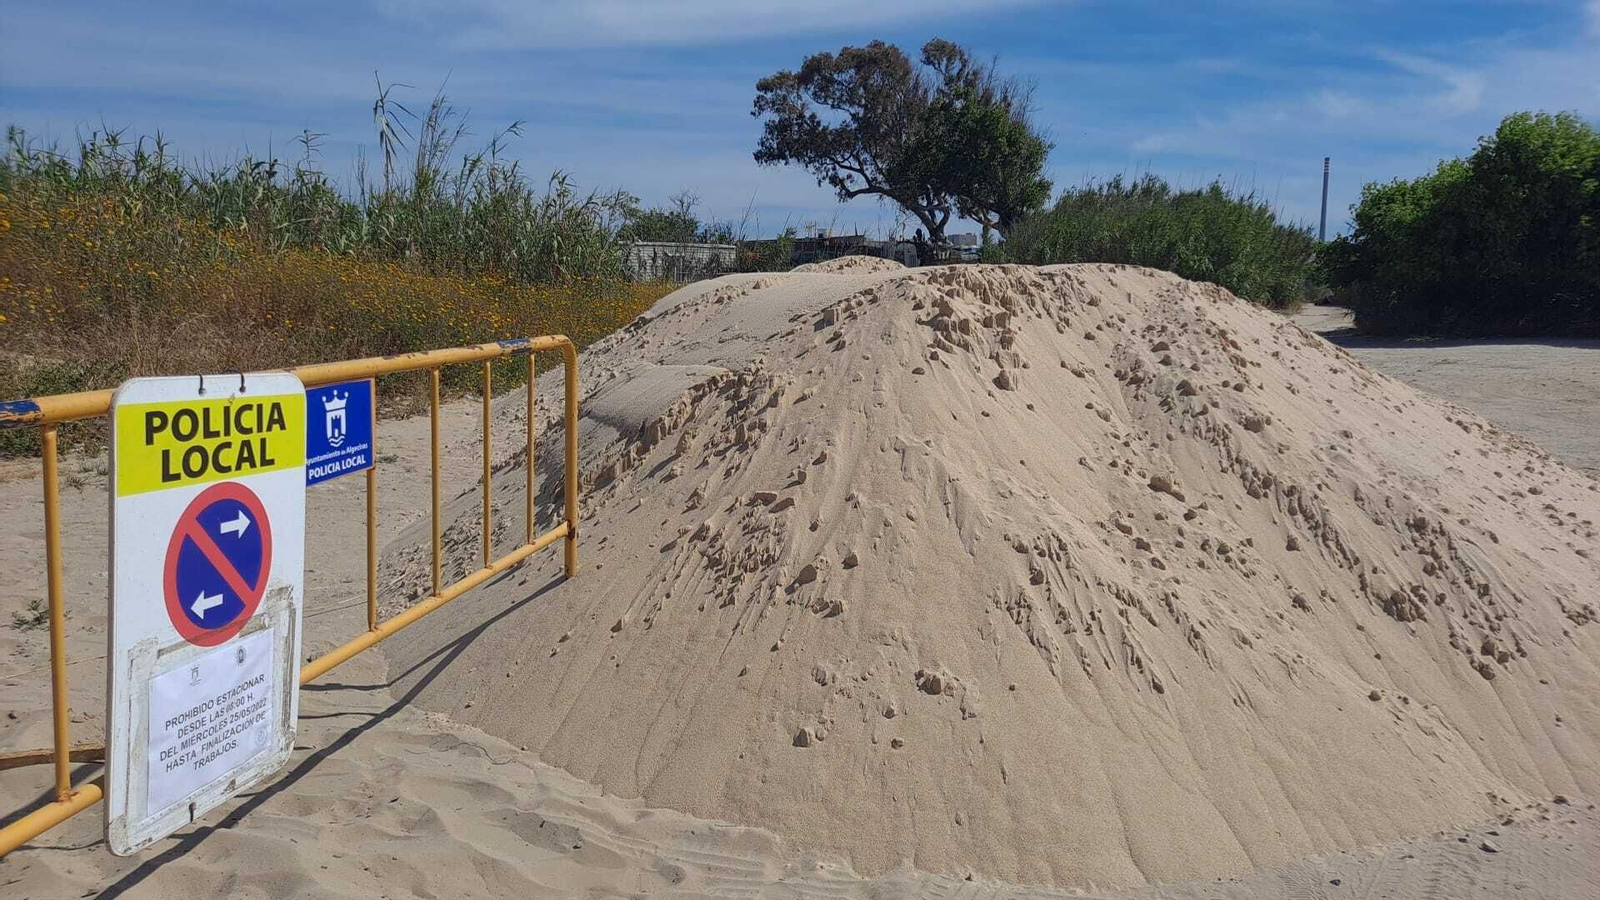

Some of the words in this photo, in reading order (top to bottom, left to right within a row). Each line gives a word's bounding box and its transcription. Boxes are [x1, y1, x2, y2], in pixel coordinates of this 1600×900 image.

[145, 402, 287, 446] POLICIA
[161, 437, 275, 483] LOCAL
[308, 461, 341, 480] POLICIA
[341, 454, 366, 470] LOCAL
[165, 700, 215, 731] PROHIBIDO
[216, 674, 265, 706] ESTACIONAR
[178, 716, 207, 739] DESDE
[209, 705, 225, 723] LAS
[160, 745, 178, 762] DEL
[229, 698, 267, 724] 25/05/2022
[166, 749, 197, 773] HASTA
[255, 710, 267, 723] DE
[193, 740, 239, 771] TRABAJOS.
